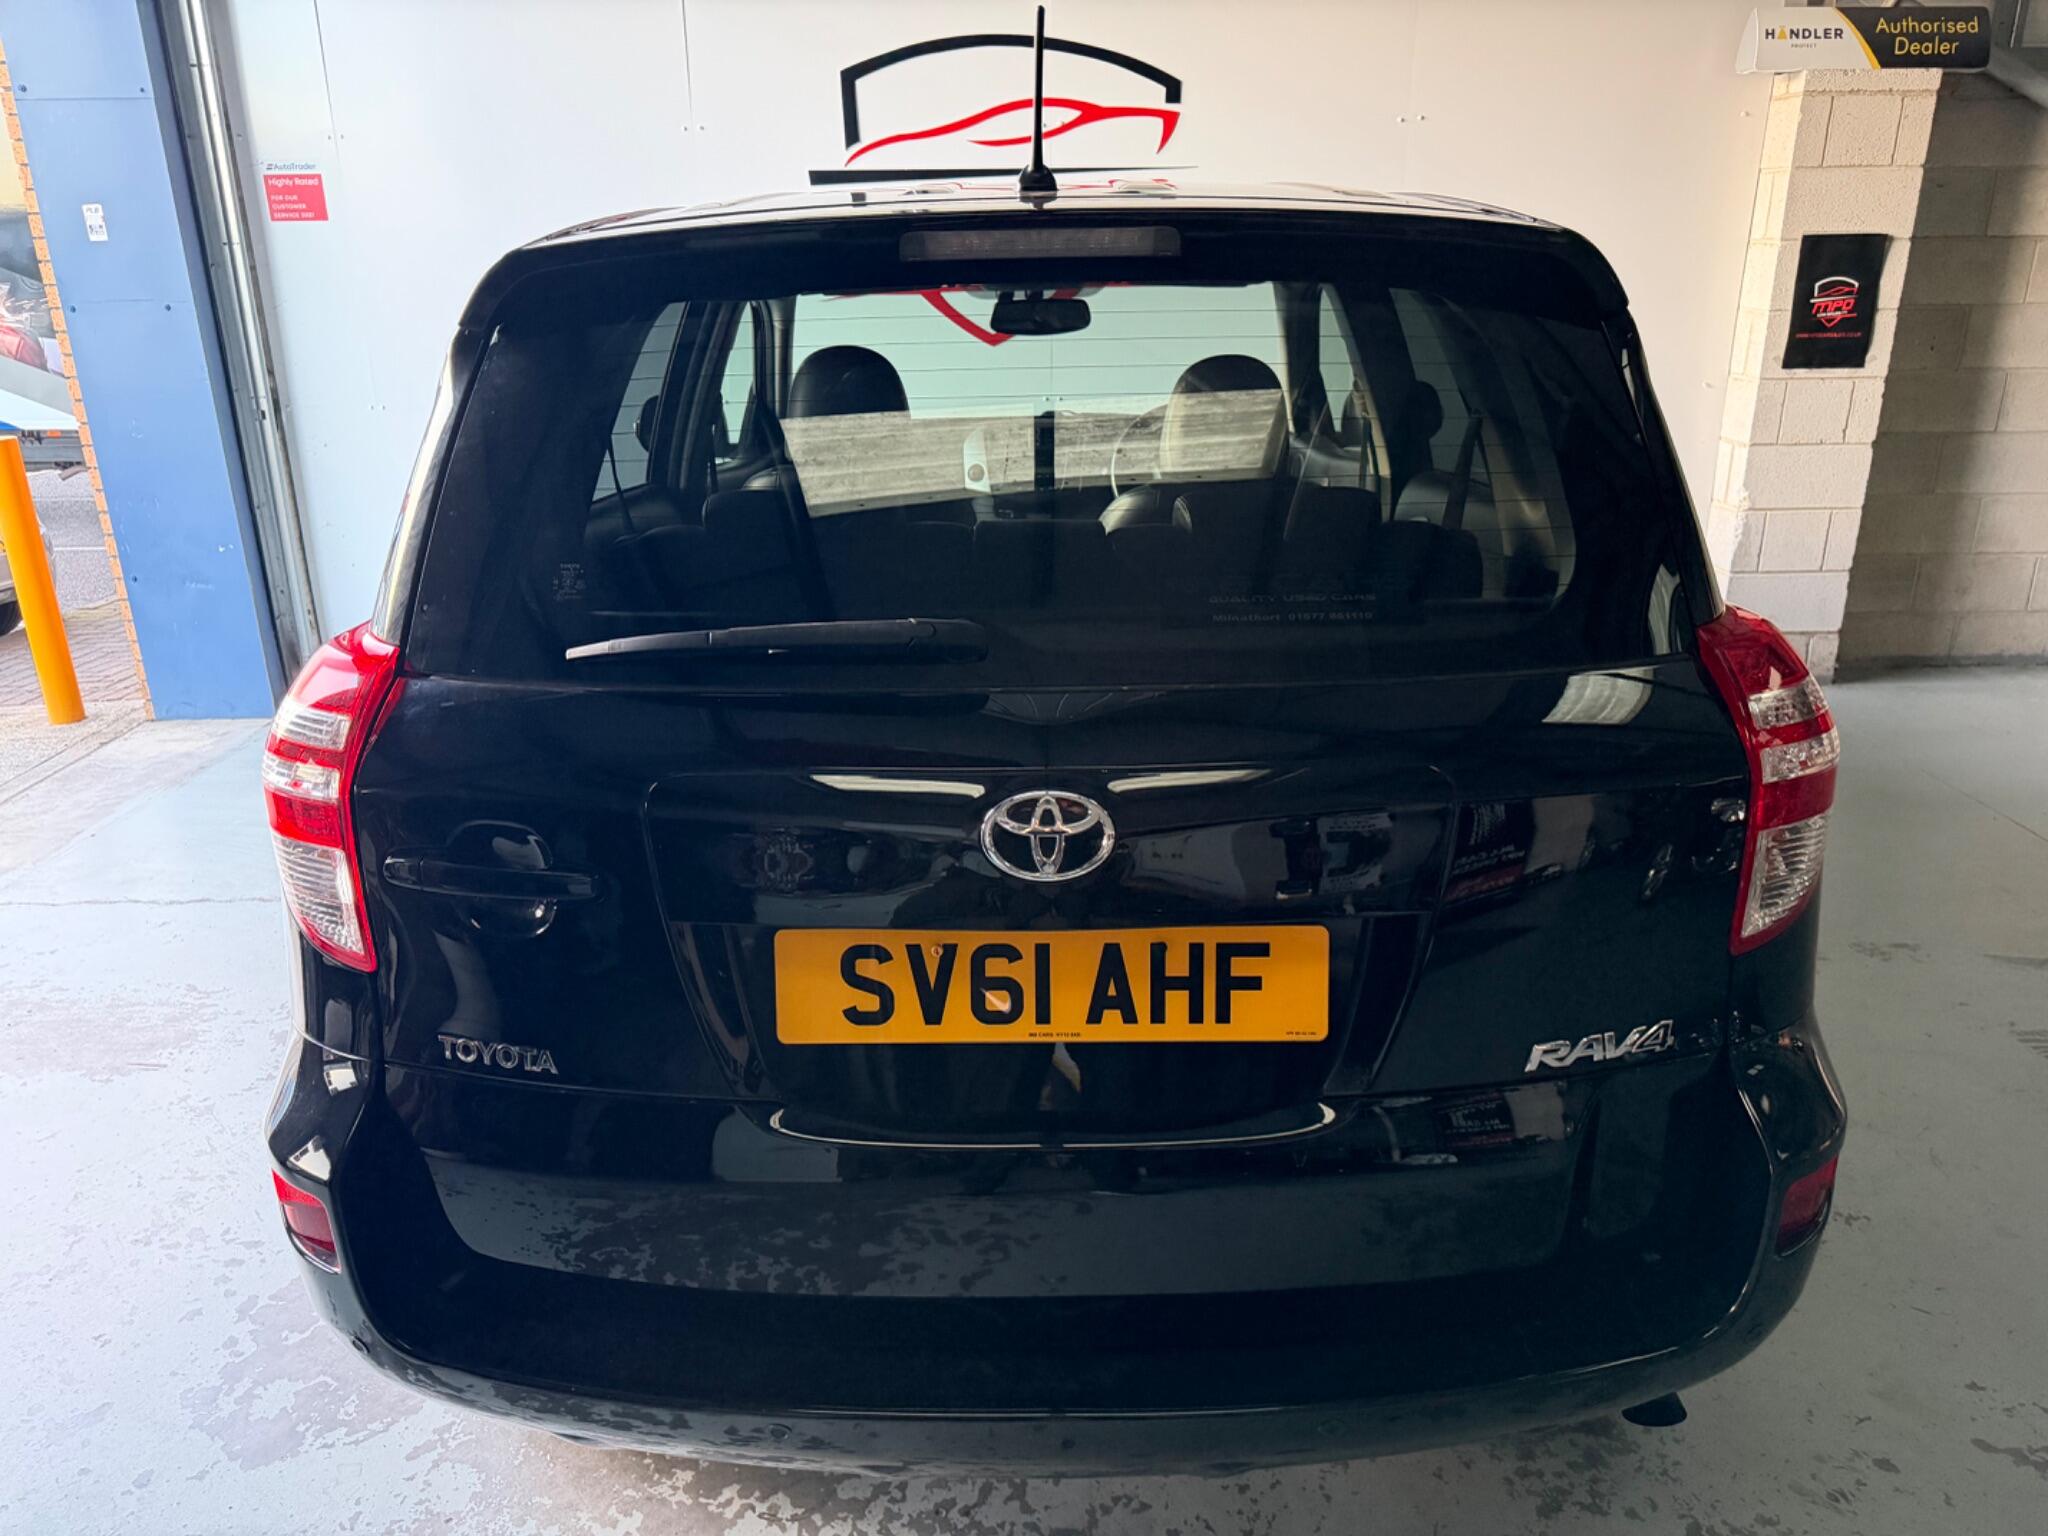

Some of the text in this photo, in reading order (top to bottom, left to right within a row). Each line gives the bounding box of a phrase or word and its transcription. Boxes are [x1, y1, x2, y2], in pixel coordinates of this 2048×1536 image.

[1875, 15, 1979, 34] Authorised
[1894, 35, 1959, 55] Dealer
[268, 177, 319, 187] Highly Rated
[840, 942, 1271, 1026] SV61 AHF
[438, 1034, 559, 1075] TOYOTA
[1525, 1019, 1674, 1073] RAV4
